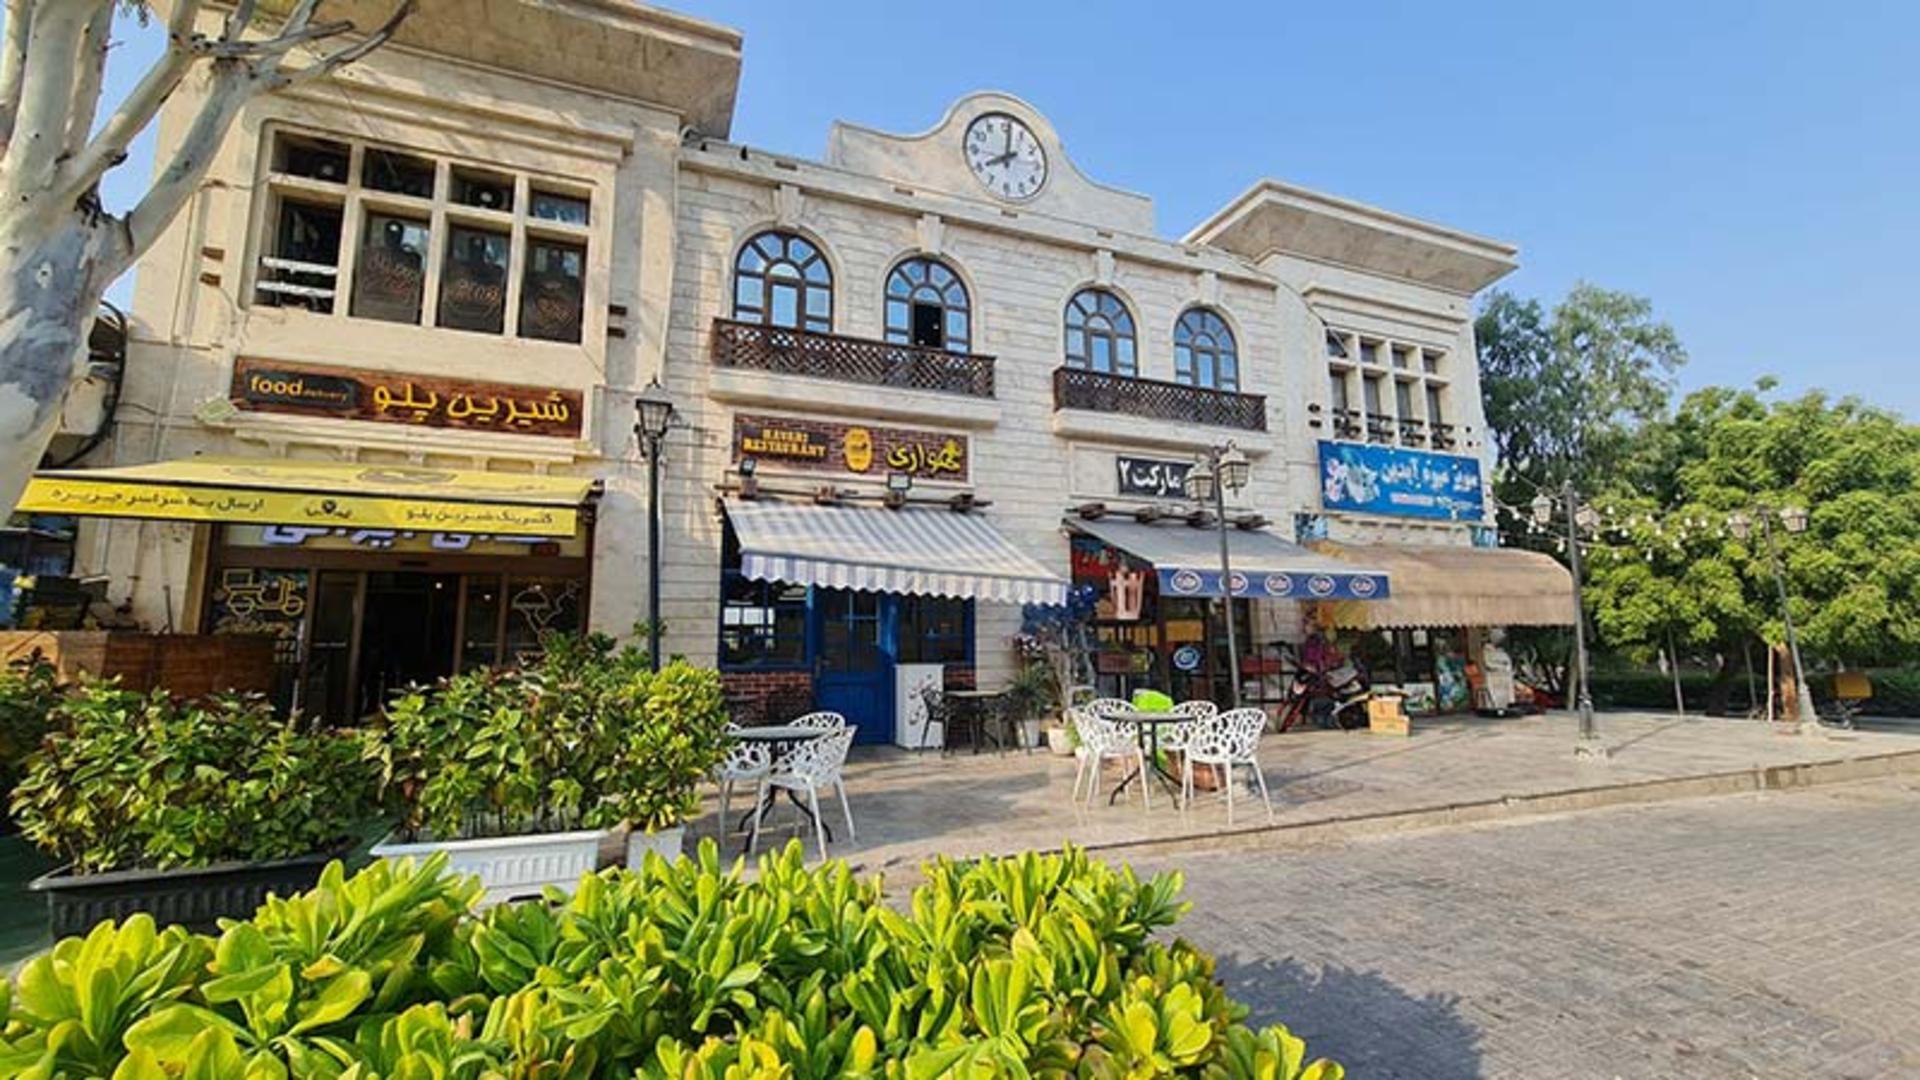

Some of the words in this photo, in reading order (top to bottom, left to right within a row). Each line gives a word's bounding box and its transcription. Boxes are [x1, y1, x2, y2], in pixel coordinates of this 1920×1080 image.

[250, 375, 304, 397] food
[372, 382, 439, 421] پلو
[446, 390, 569, 426] شیرین
[743, 437, 826, 459] RESTAURANT
[218, 497, 264, 512] ارسال
